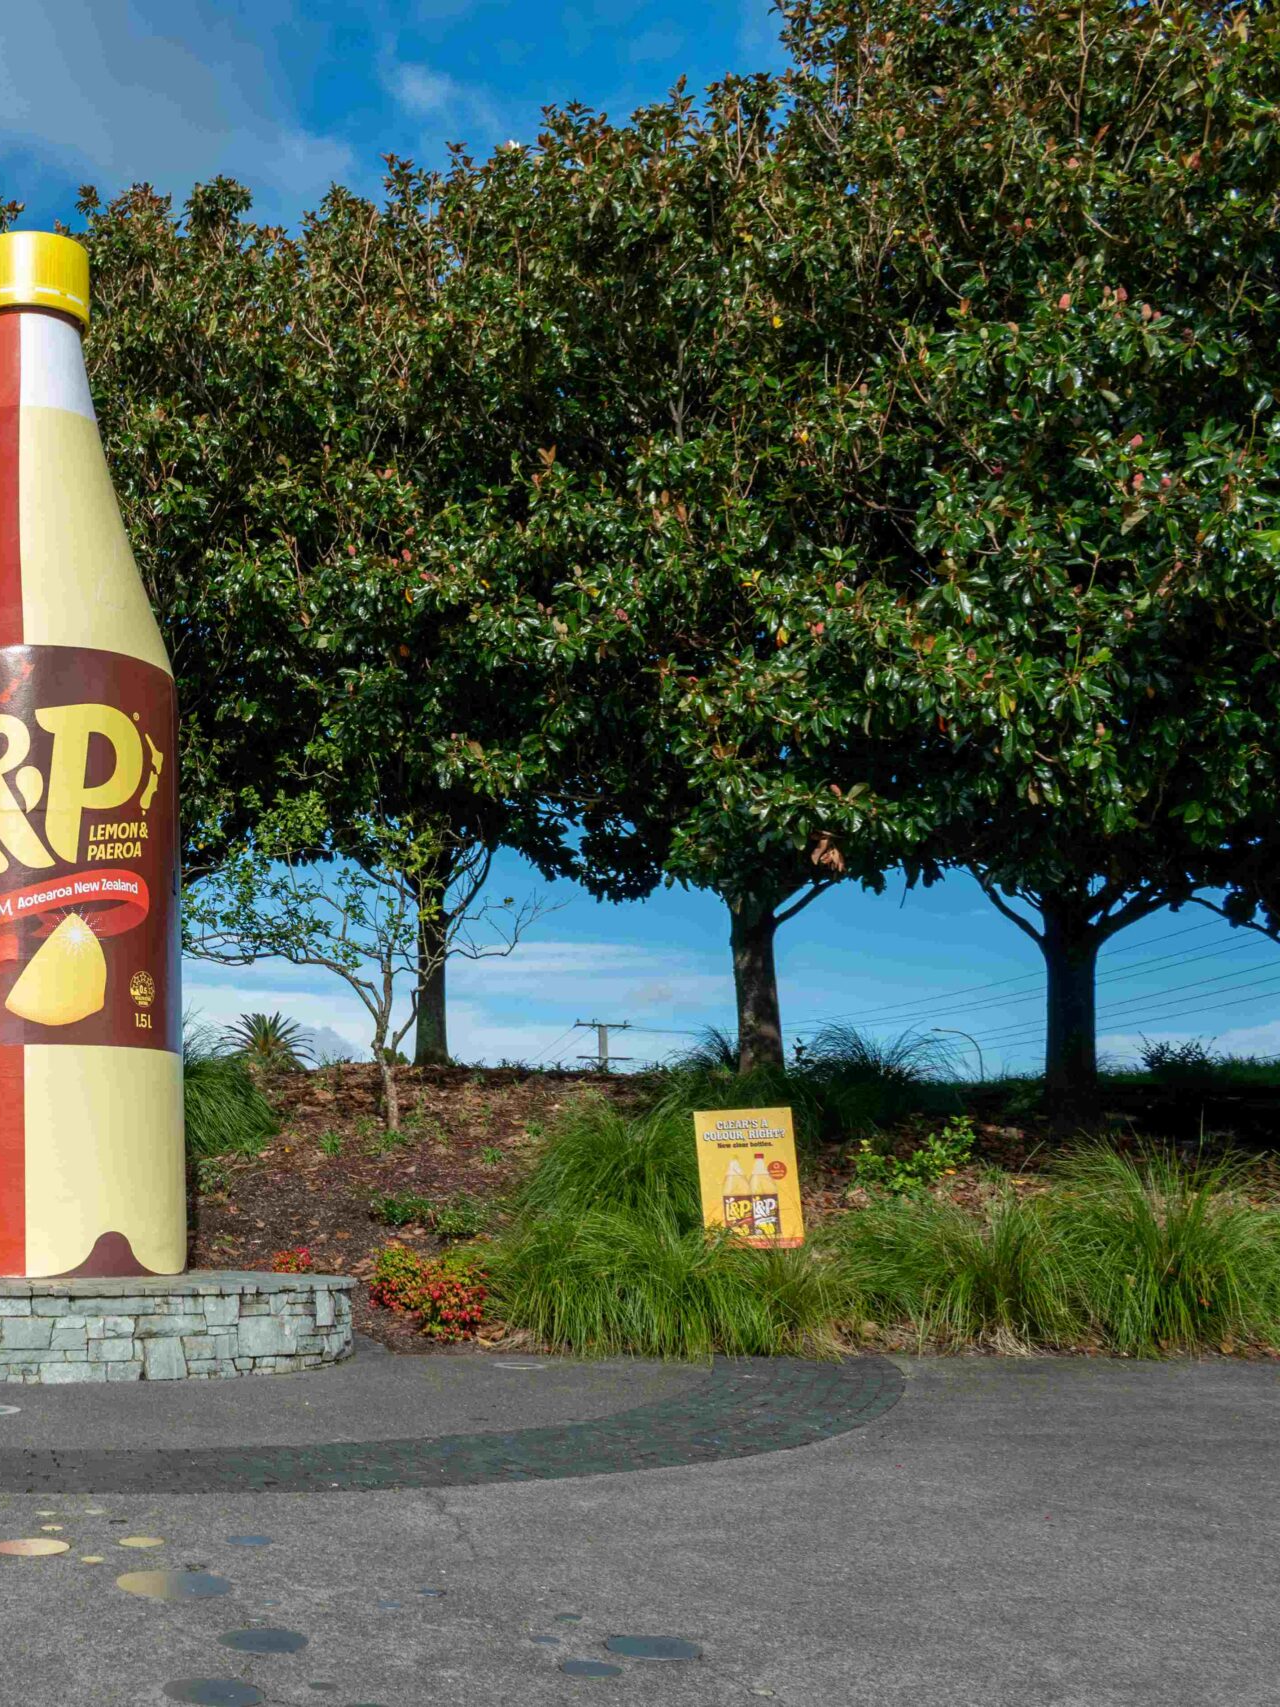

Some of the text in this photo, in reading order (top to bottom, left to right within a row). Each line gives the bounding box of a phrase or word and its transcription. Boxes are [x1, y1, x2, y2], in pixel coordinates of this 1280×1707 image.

[87, 842, 142, 862] PAEROA
[17, 885, 73, 910] Aotearoa
[74, 880, 100, 895] New
[101, 878, 139, 895] Zealand
[716, 1119, 768, 1130] CLEAR'S A
[725, 1199, 752, 1221] L&P
